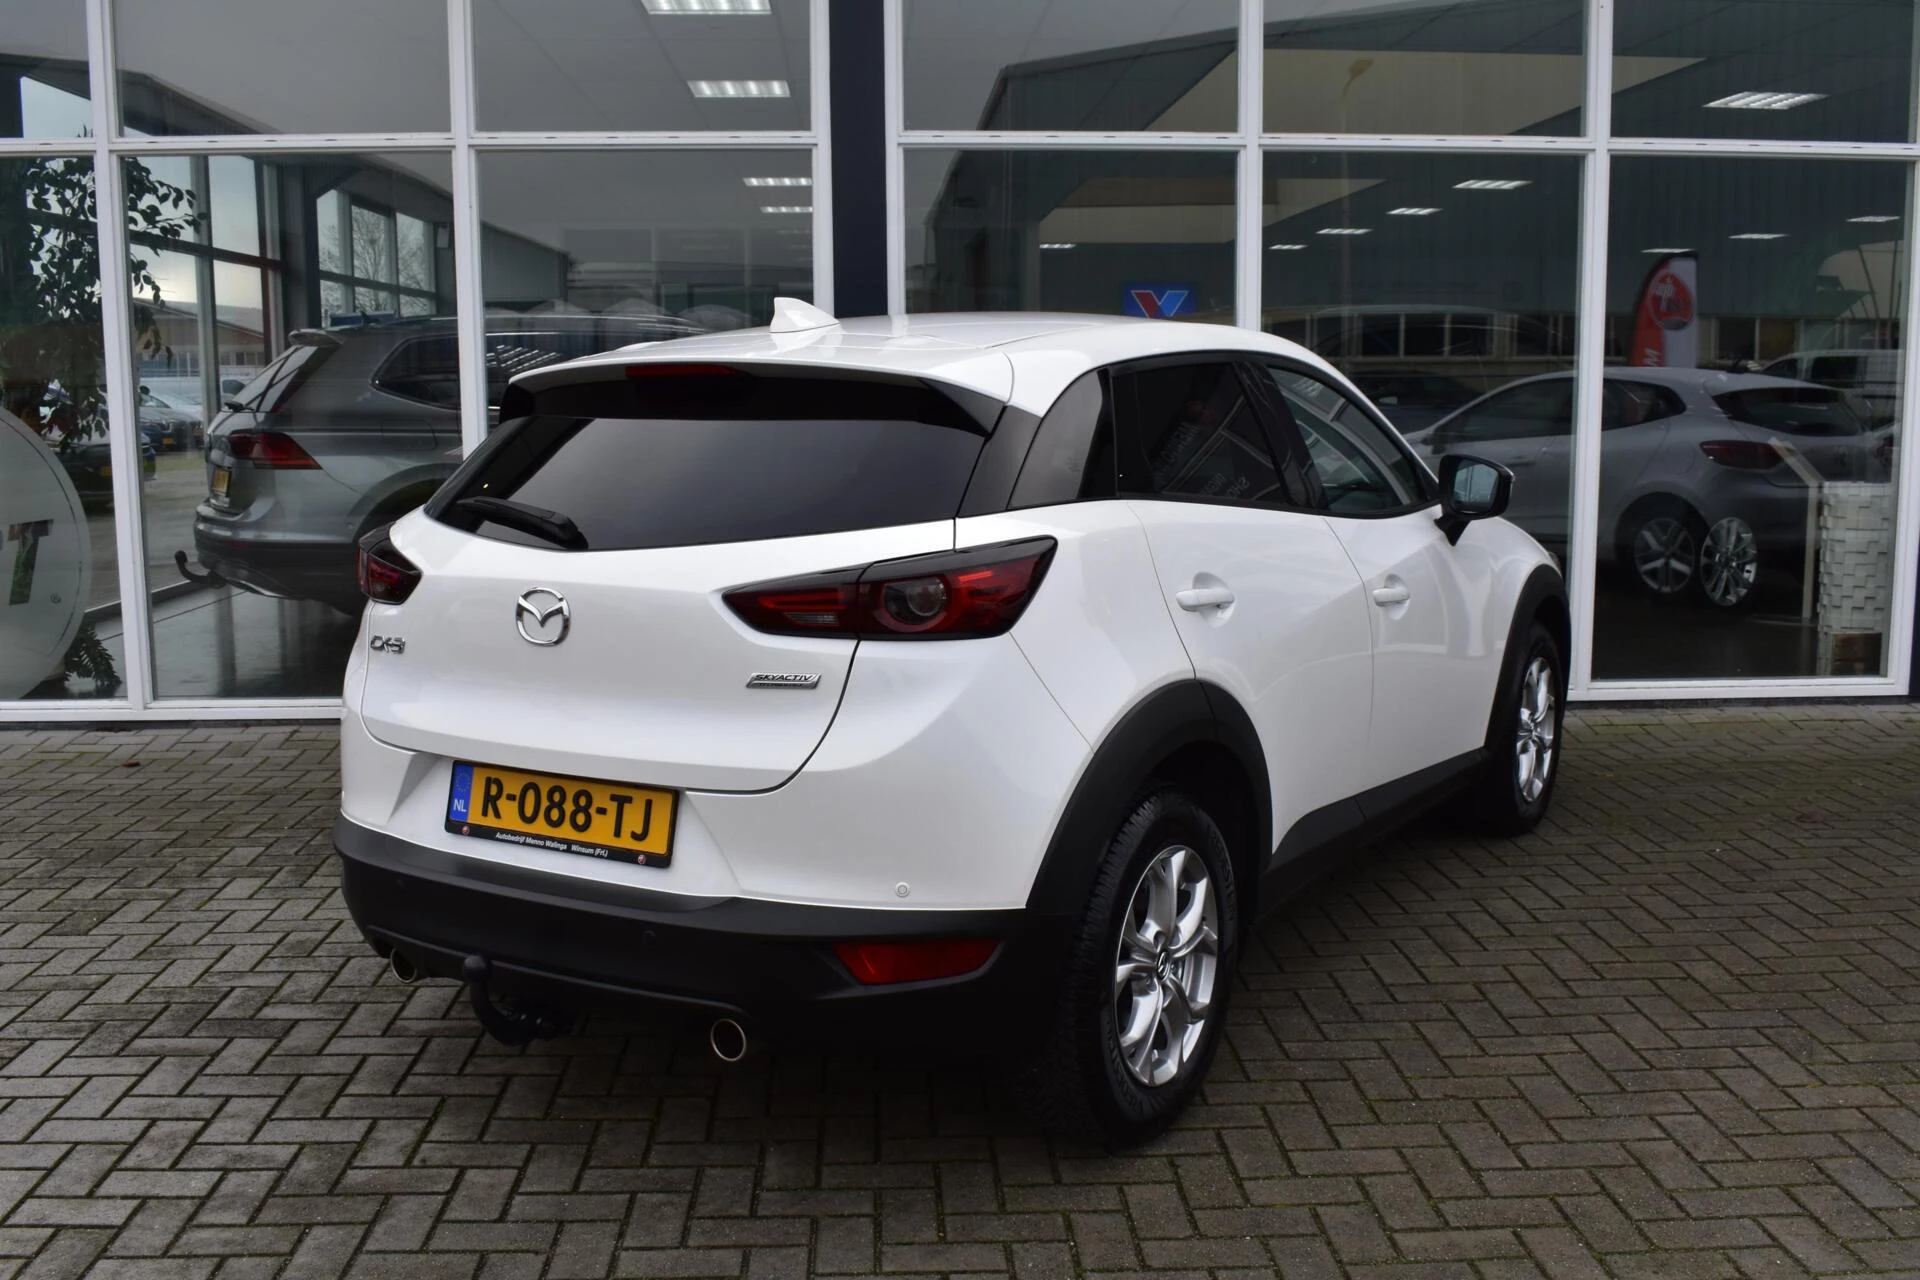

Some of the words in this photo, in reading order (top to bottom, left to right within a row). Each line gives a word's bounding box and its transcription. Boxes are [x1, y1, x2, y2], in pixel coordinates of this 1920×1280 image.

[755, 674, 813, 682] SKYACTIV
[453, 798, 467, 813] NL
[481, 776, 653, 842] R-088-TJ
[496, 832, 526, 844] Autobedrijf
[526, 836, 545, 847] Menno
[571, 844, 594, 855] Winsum
